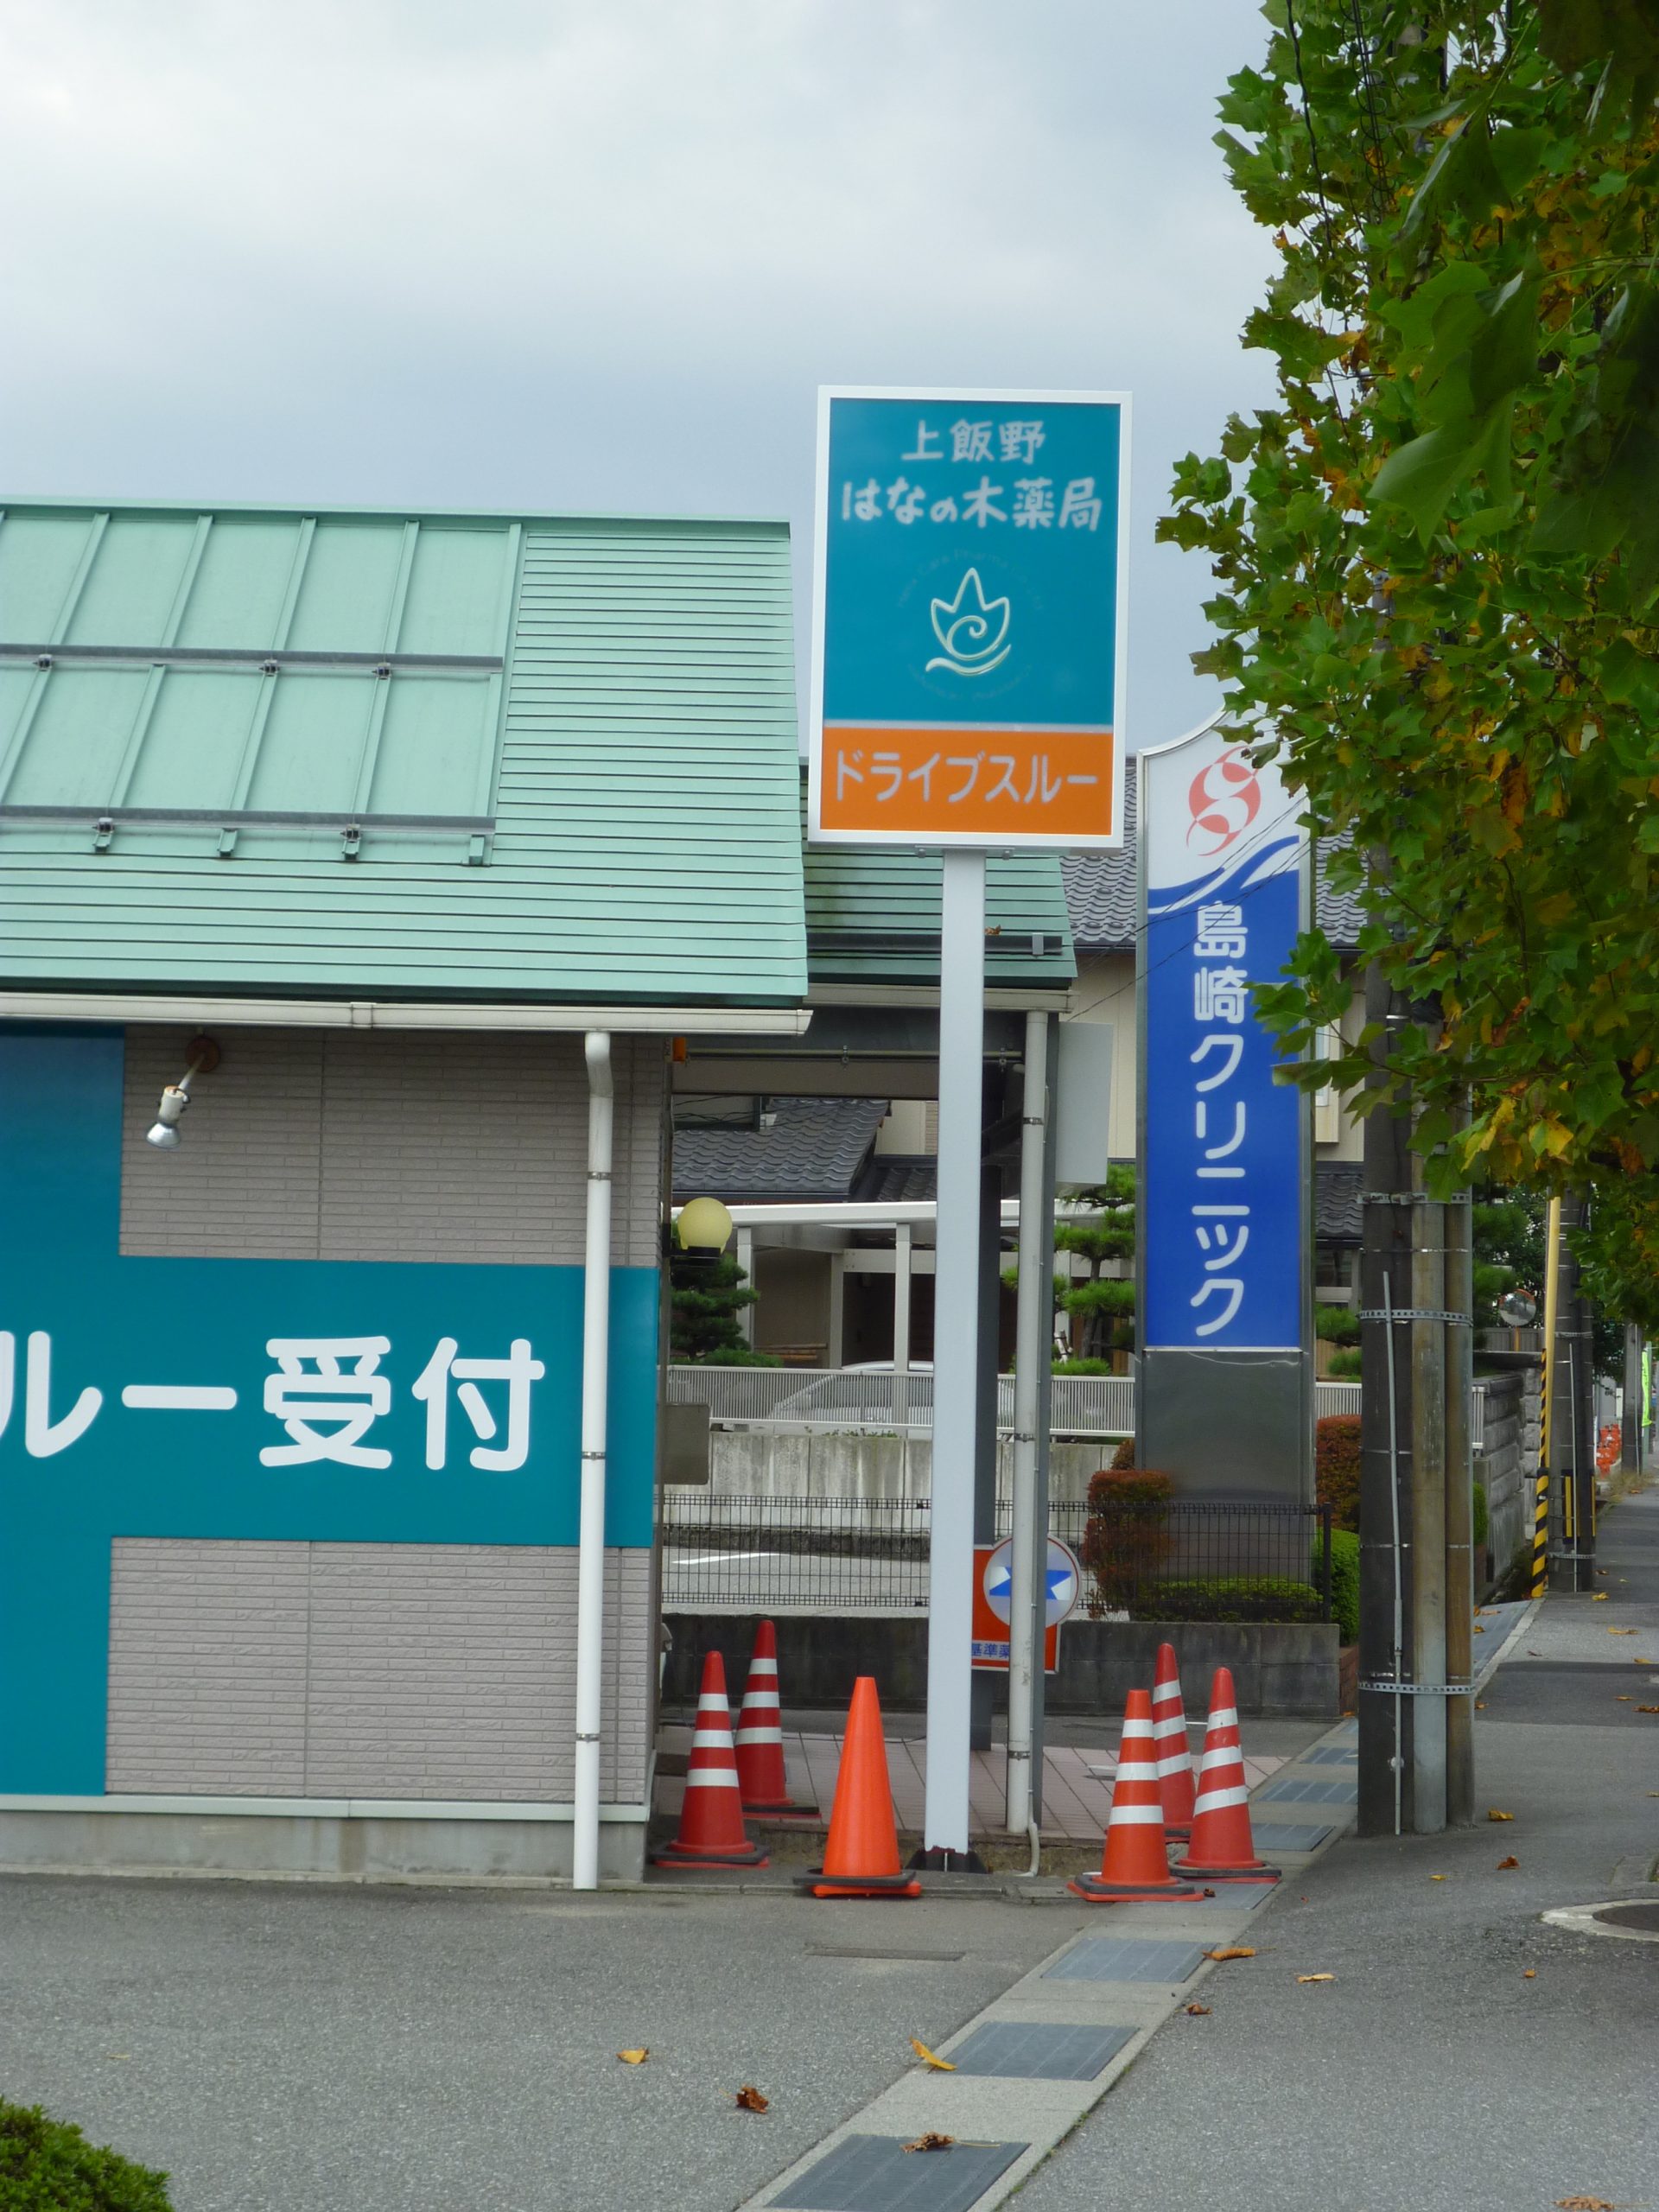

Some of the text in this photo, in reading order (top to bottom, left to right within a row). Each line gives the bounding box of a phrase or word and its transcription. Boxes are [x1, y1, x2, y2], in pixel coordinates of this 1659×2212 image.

[901, 419, 1046, 464] 上飯野
[841, 476, 1103, 531] はなの木薬局
[836, 749, 1098, 804] ドライブスルー
[1190, 900, 1250, 1337] 島崎クリニック
